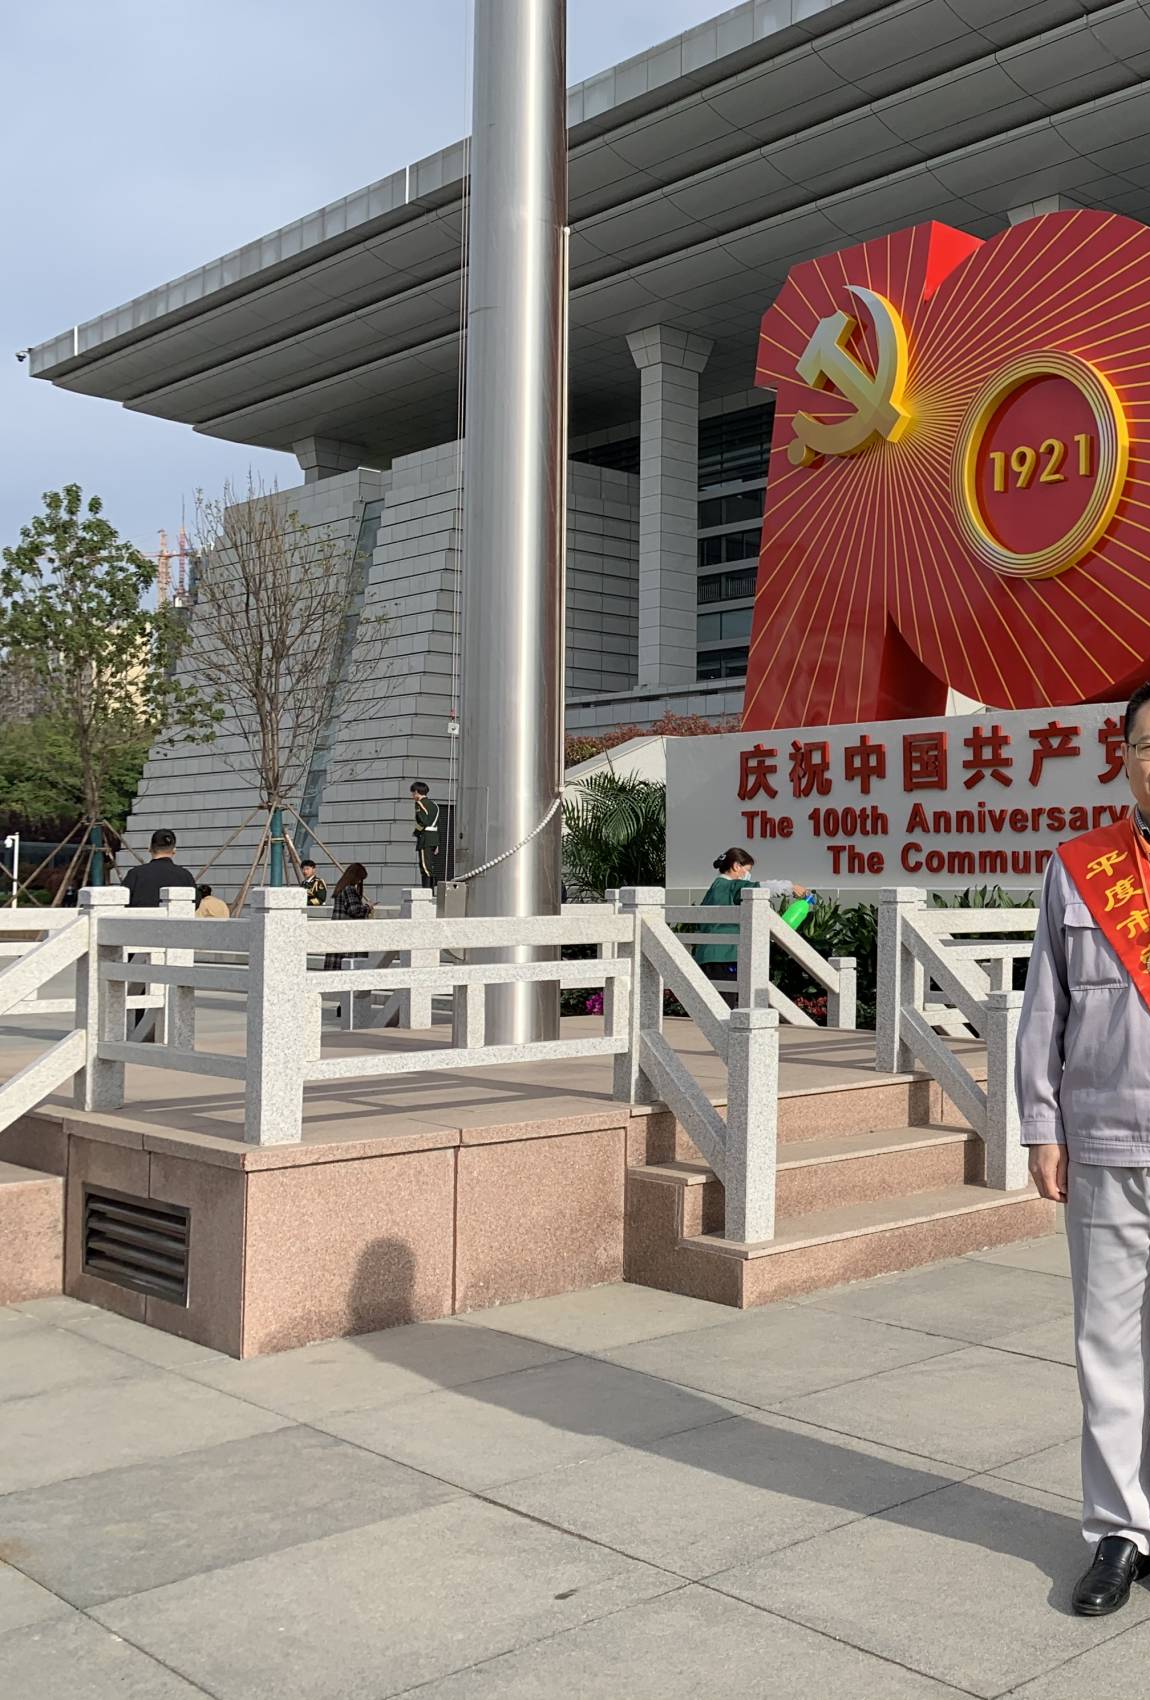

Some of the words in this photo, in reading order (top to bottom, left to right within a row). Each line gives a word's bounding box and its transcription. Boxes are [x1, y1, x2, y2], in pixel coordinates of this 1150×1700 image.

[989, 432, 1094, 494] 1921
[741, 811, 794, 839] The
[808, 806, 889, 837] 100th
[906, 801, 1129, 835] Anniversary
[828, 845, 884, 875] The
[900, 841, 1063, 875] Commun
